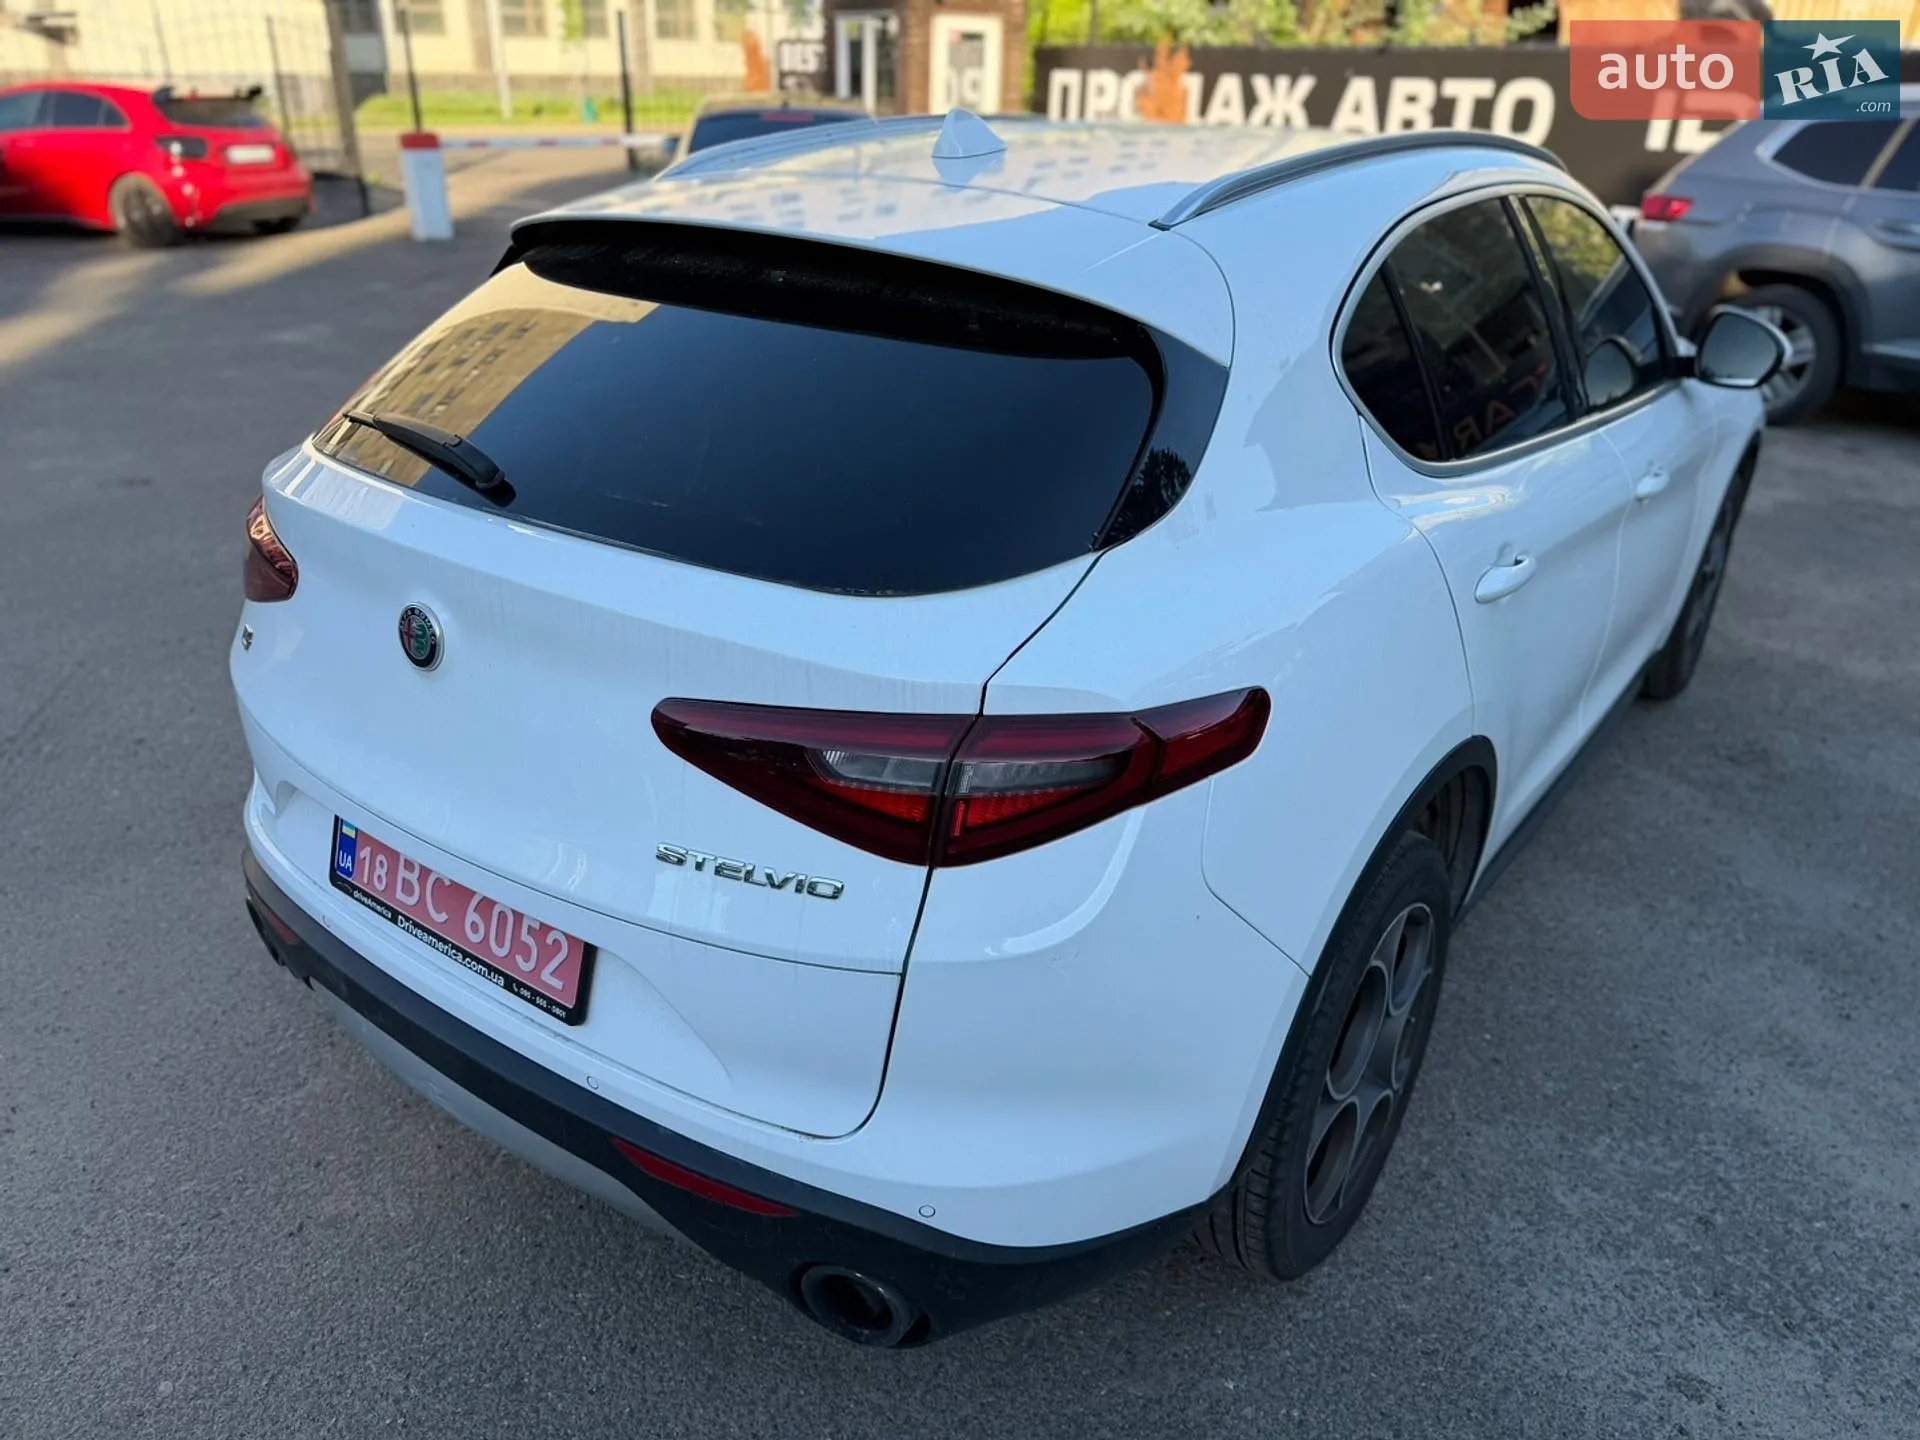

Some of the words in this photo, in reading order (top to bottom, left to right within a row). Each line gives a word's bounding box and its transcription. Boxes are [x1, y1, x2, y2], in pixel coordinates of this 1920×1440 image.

[1329, 76, 1556, 147] АВТО
[339, 850, 353, 872] UA
[655, 841, 846, 900] STELVIO
[360, 846, 388, 892] 18
[395, 854, 452, 923] BC
[464, 892, 569, 990] 6052
[397, 915, 505, 987] Driveamerica.com.ua
